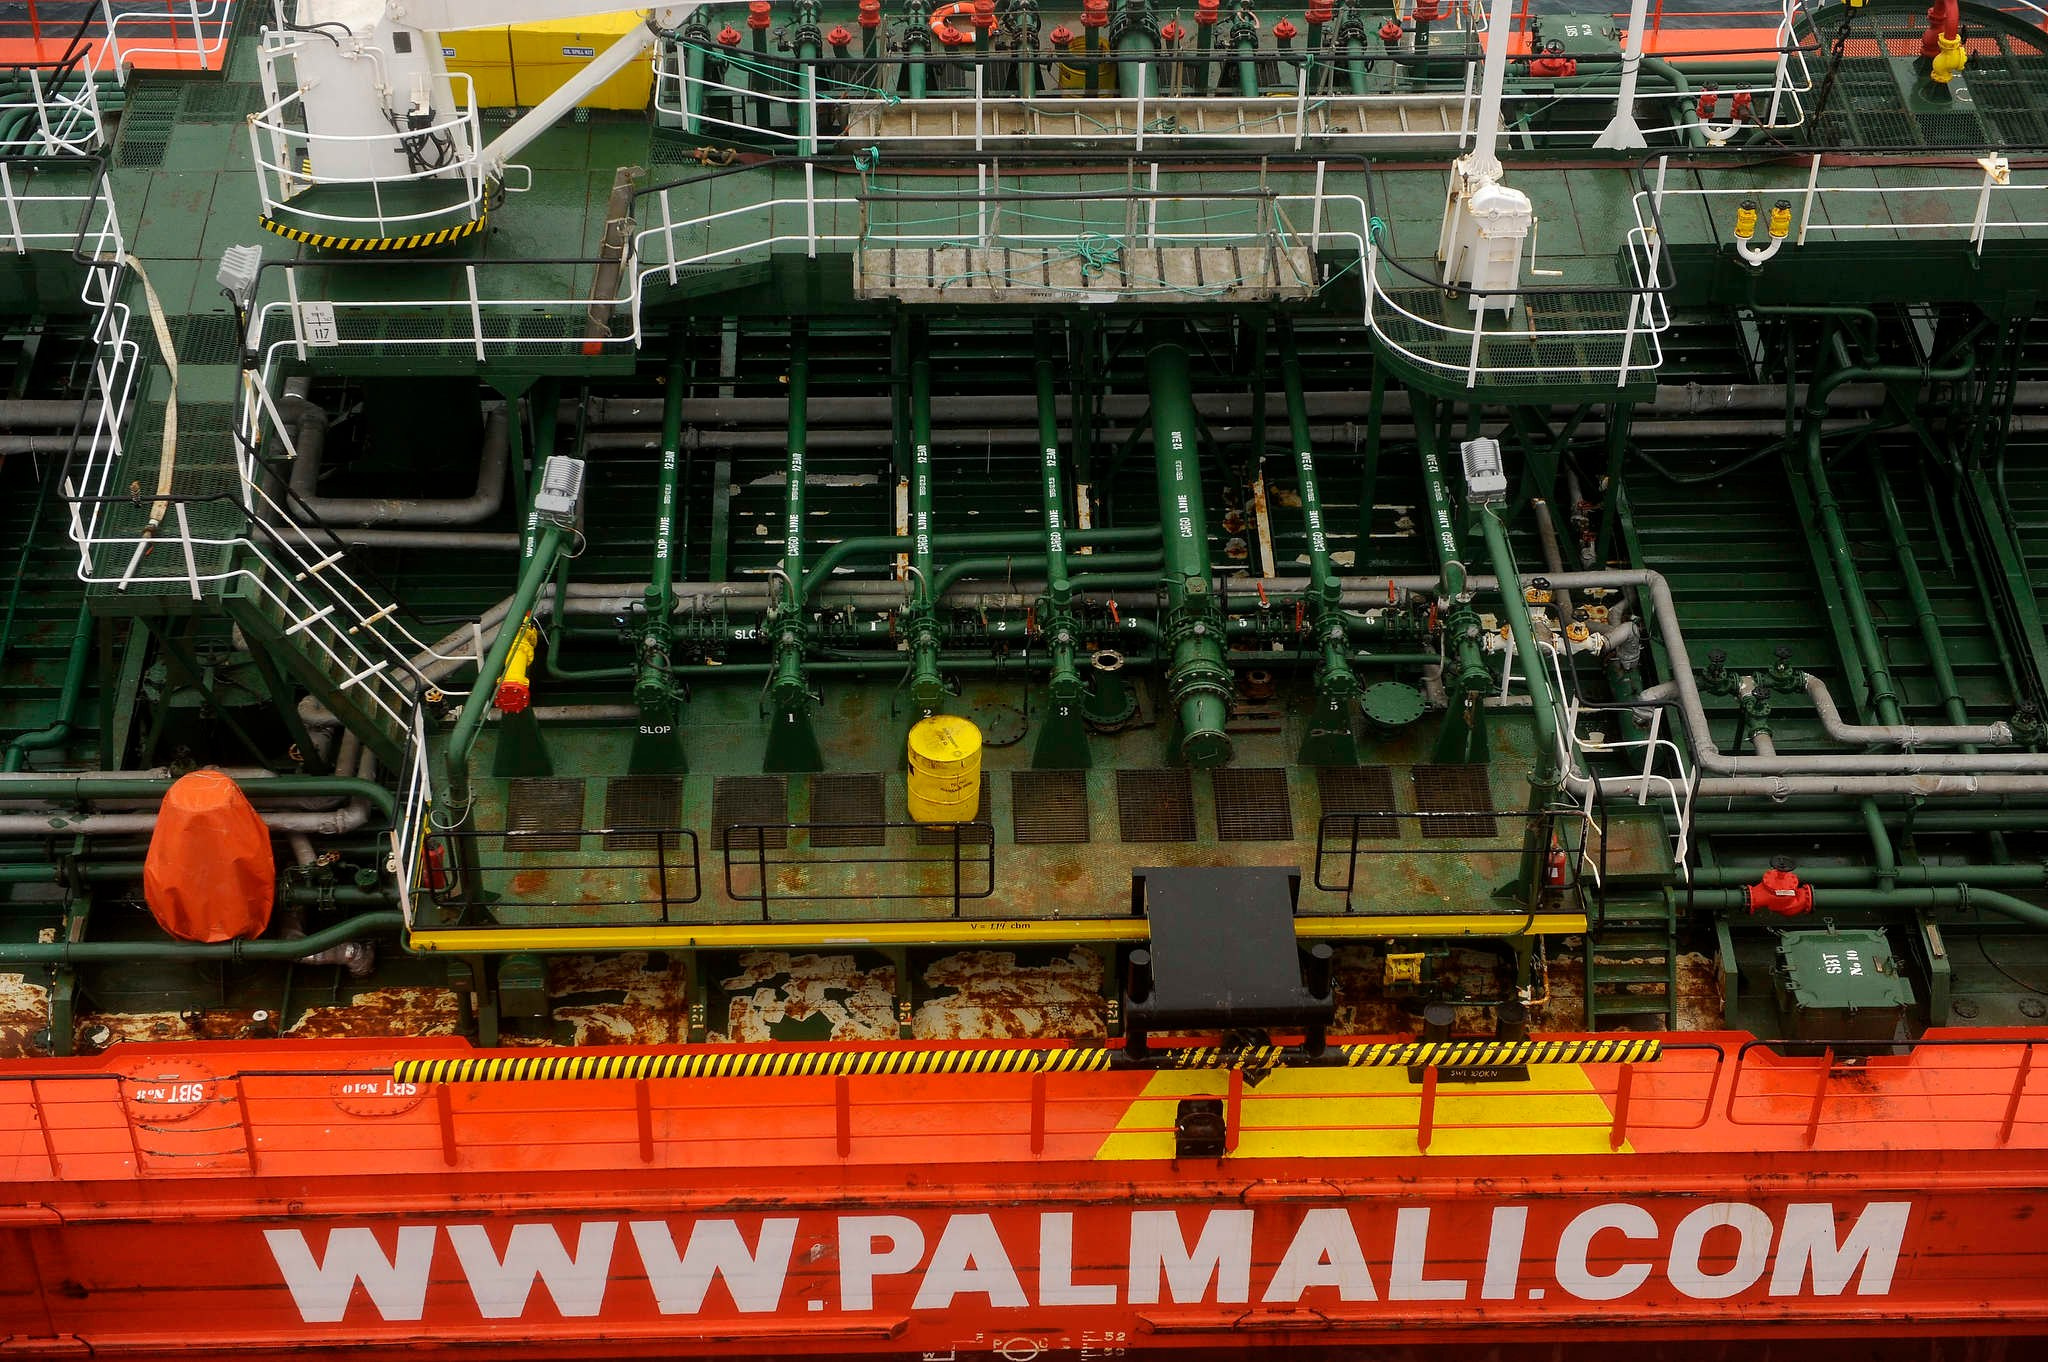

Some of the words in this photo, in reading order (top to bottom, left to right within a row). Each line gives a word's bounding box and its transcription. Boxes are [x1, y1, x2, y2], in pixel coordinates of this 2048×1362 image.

[1178, 494, 1188, 513] LINE
[660, 517, 670, 536] LINE
[789, 514, 799, 533] LINE
[918, 512, 927, 530] LINE
[1050, 510, 1059, 528] LINE
[1180, 517, 1192, 537] CARGO
[1309, 510, 1320, 528] LINE
[1438, 509, 1450, 528] LINE
[657, 538, 668, 558] SLOP
[1050, 532, 1062, 552] CARGO
[1312, 531, 1326, 552] CARGO
[1442, 531, 1456, 552] CARGO
[870, 621, 876, 631] 1
[998, 622, 1006, 630] 2
[1128, 618, 1136, 628] 3
[1239, 619, 1247, 627] 5
[1366, 616, 1375, 625] 6
[924, 709, 932, 718] 2
[1060, 706, 1068, 716] 3
[1330, 701, 1338, 710] 5
[788, 714, 794, 722] 1
[639, 726, 671, 734] SLOP
[1823, 953, 1842, 974] SBT
[1107, 1000, 1119, 1023] 129
[168, 1084, 203, 1103] SBT
[263, 1201, 1911, 1323] WWW.PALMALI.COM
[1104, 1332, 1126, 1341] 52
